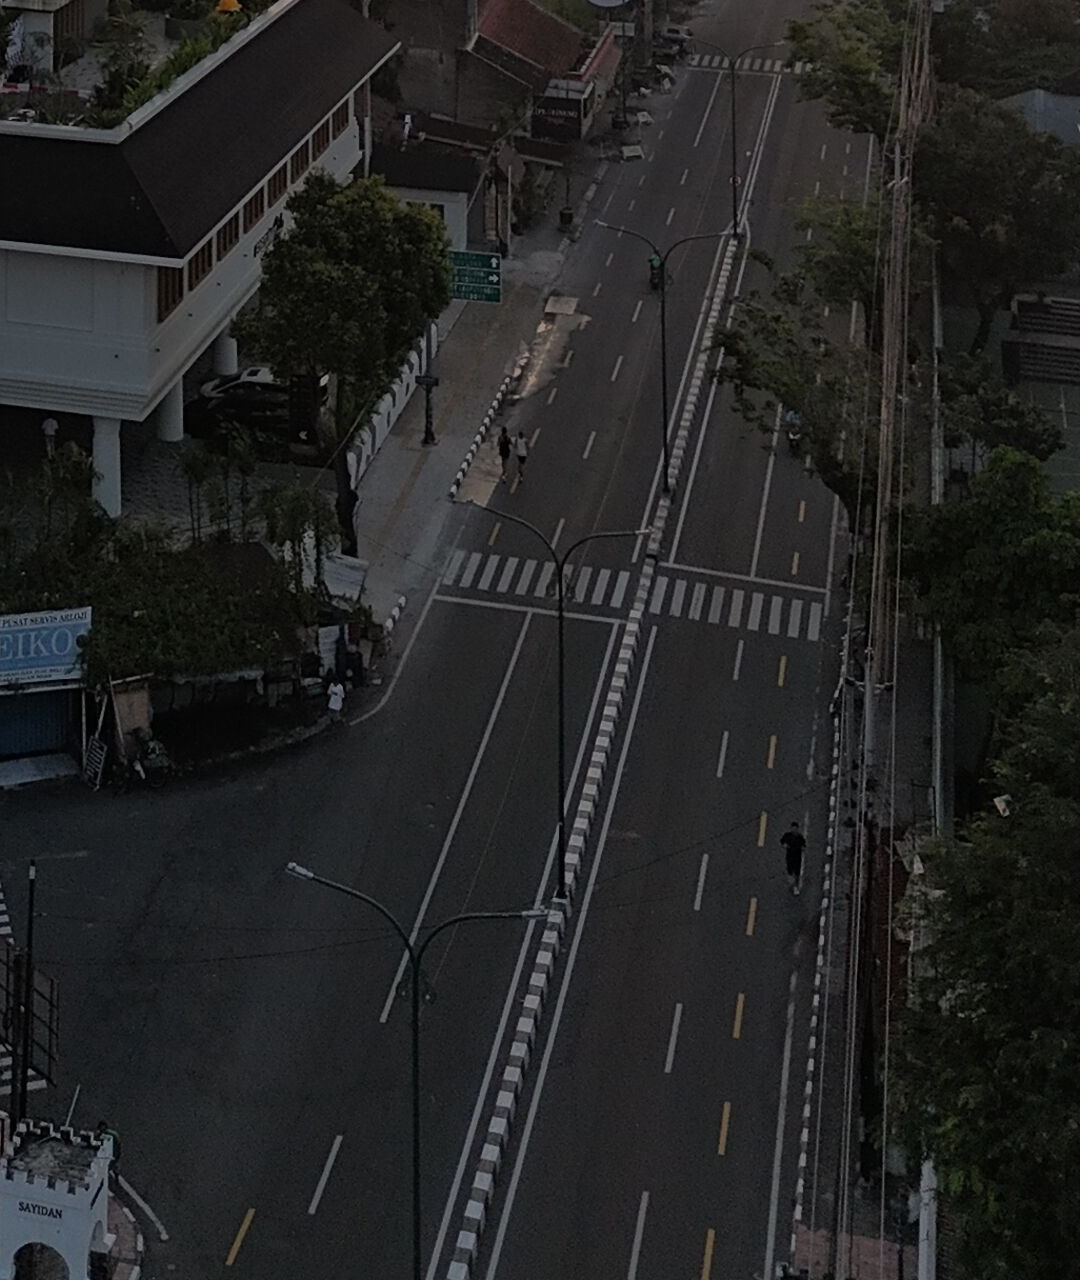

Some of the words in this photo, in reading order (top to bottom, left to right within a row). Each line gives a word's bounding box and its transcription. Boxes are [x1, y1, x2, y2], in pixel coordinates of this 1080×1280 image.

[2, 617, 28, 628] PUSAT
[29, 614, 58, 625] SERVIS
[59, 611, 87, 622] ARLOJI
[18, 1201, 63, 1219] SAYIDAN
